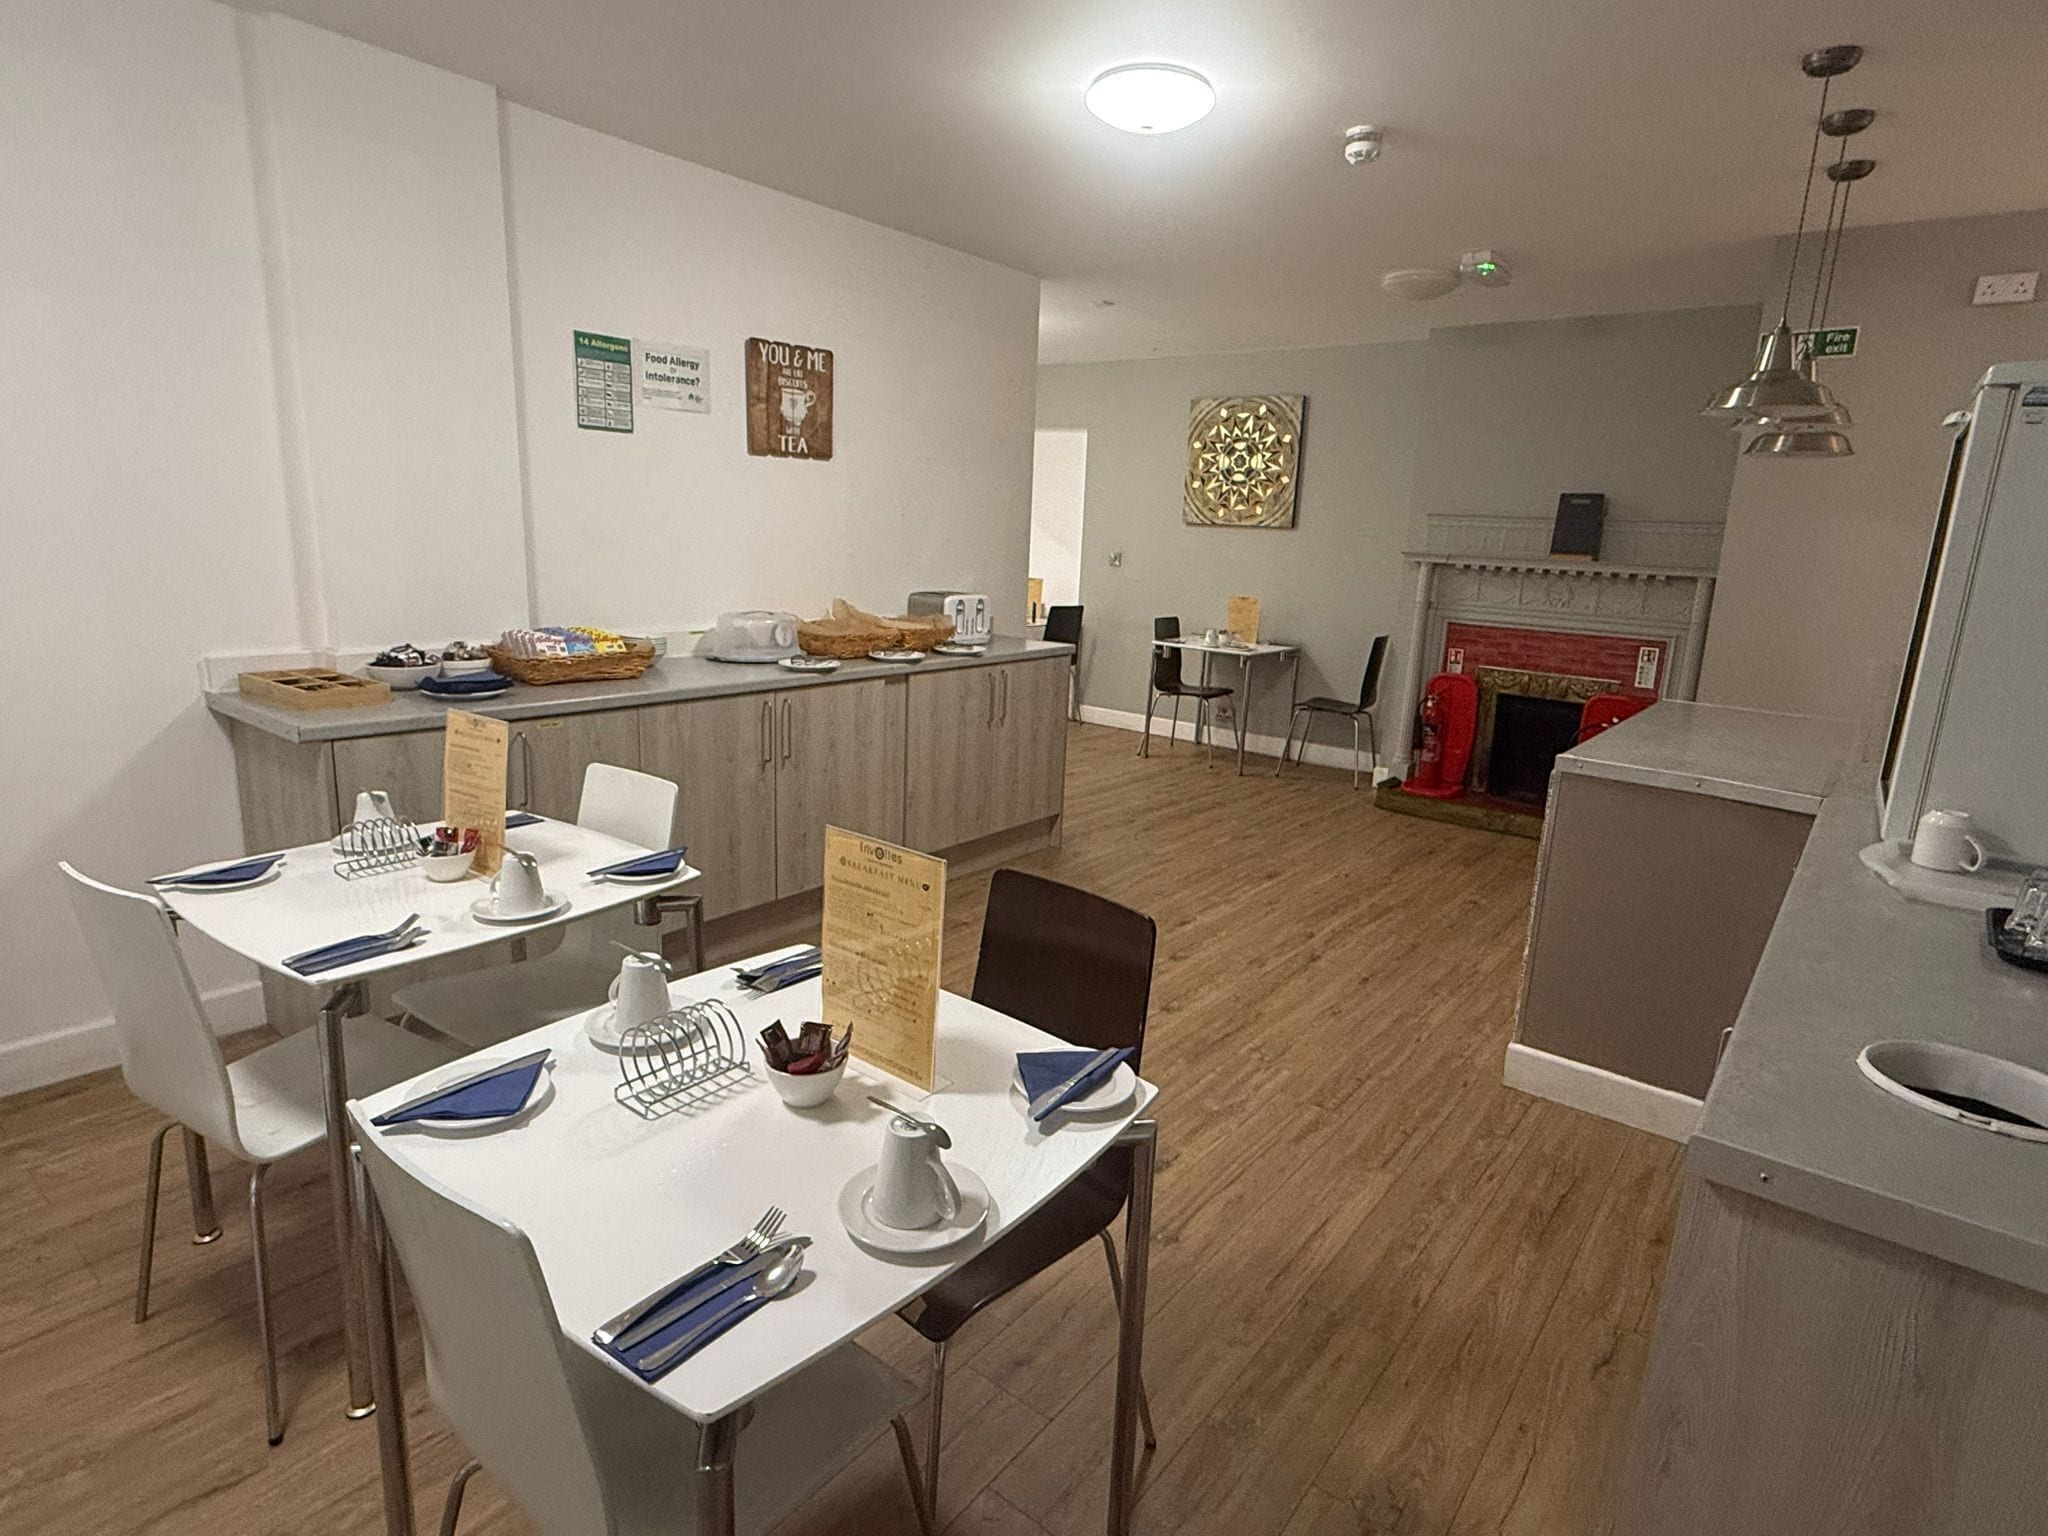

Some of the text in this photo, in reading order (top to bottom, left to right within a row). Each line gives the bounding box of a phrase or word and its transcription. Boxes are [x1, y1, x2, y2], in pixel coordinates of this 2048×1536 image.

[578, 336, 629, 353] 14 Allergens
[1825, 332, 1851, 343] Fire
[1825, 343, 1849, 354] exit
[645, 352, 700, 371] Food Allergy
[759, 342, 827, 373] YOU & ME
[645, 371, 701, 387] Intolerance?
[778, 434, 809, 454] TEA
